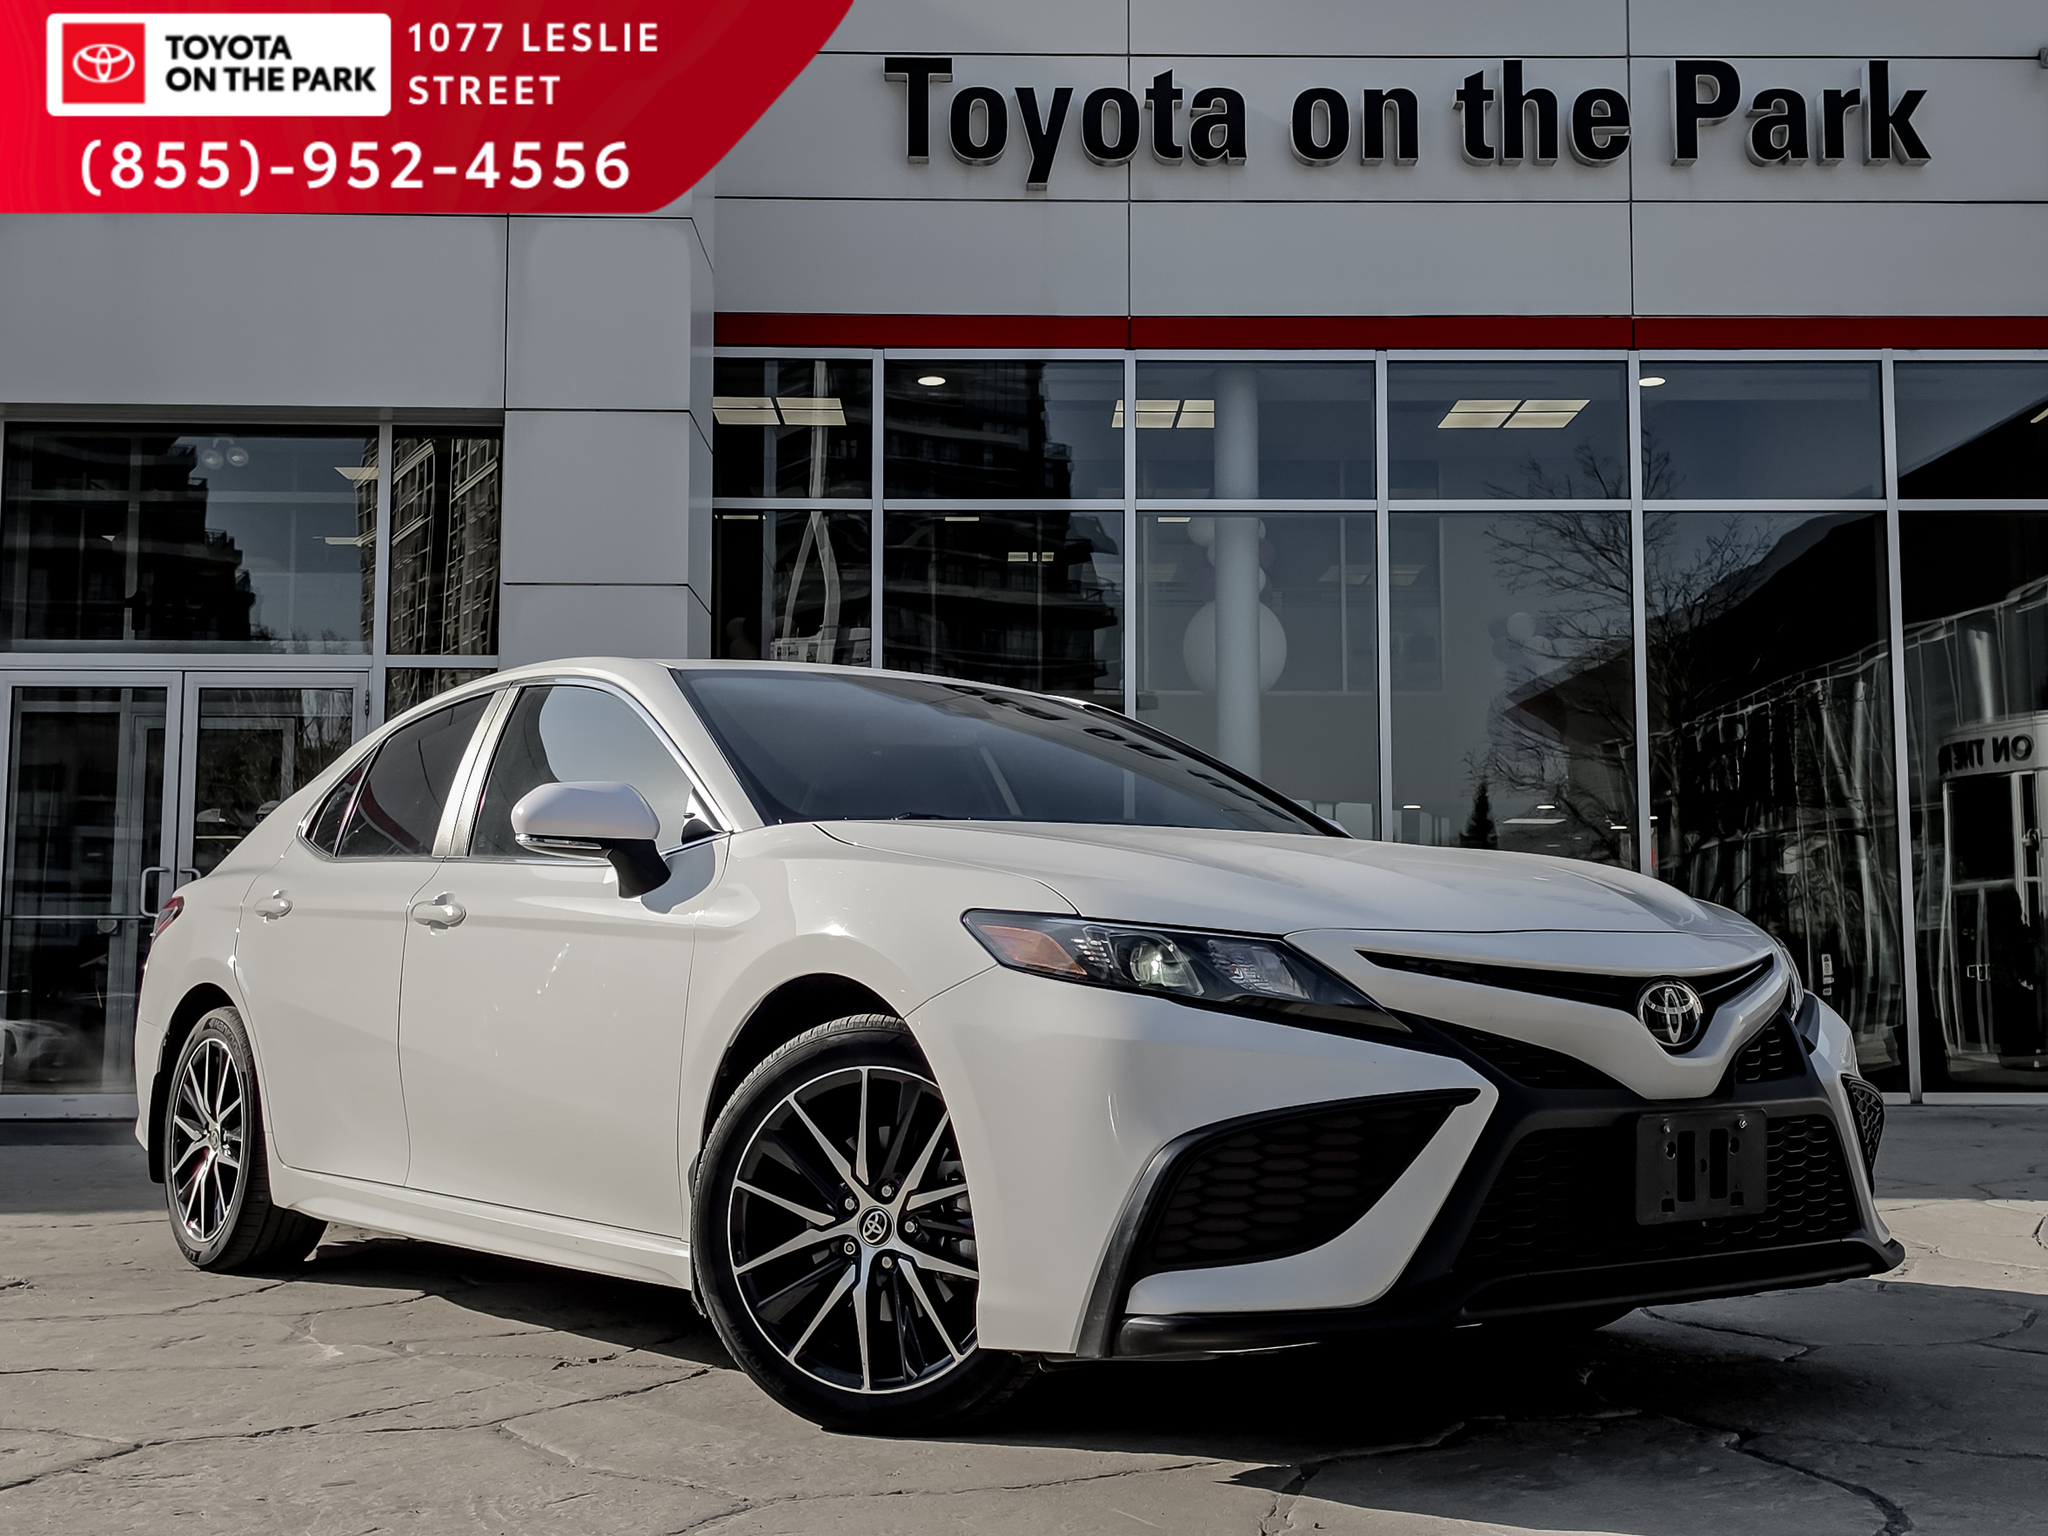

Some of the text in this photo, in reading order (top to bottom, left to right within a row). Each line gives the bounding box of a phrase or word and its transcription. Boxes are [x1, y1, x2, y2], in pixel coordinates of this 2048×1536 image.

[884, 57, 1932, 188] Toyota on the Park
